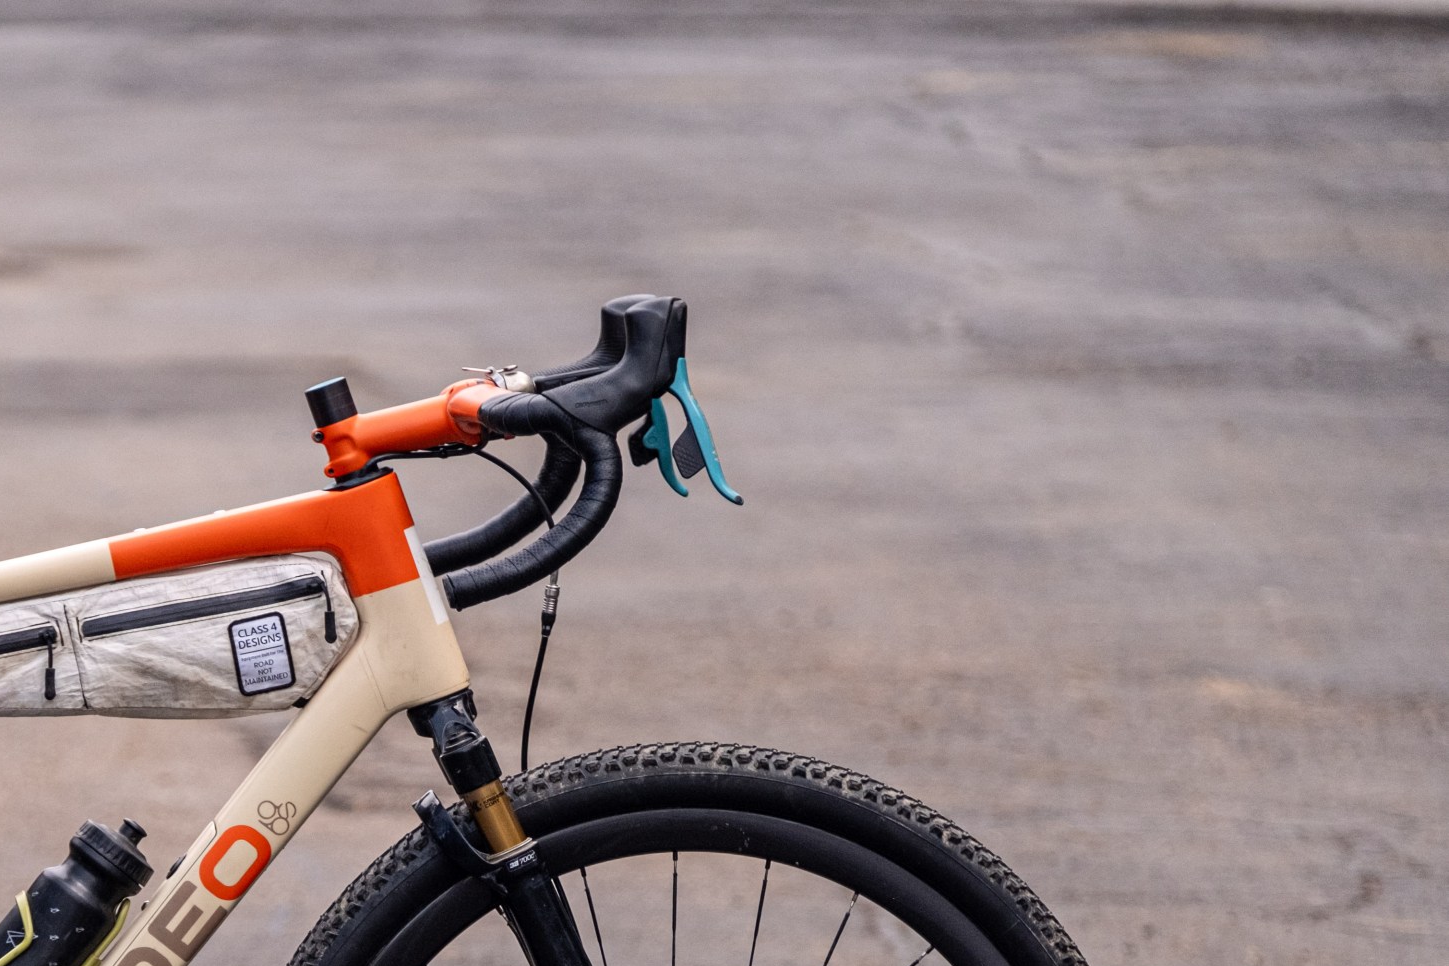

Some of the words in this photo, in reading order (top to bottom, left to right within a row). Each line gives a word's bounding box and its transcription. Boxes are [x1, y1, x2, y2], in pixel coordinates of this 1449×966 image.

[238, 625, 269, 638] CLASS
[271, 622, 277, 631] 4
[238, 632, 282, 649] DESIGNS
[254, 659, 274, 668] ROAD
[258, 667, 272, 675] NOT
[244, 672, 288, 686] MAINTAINED
